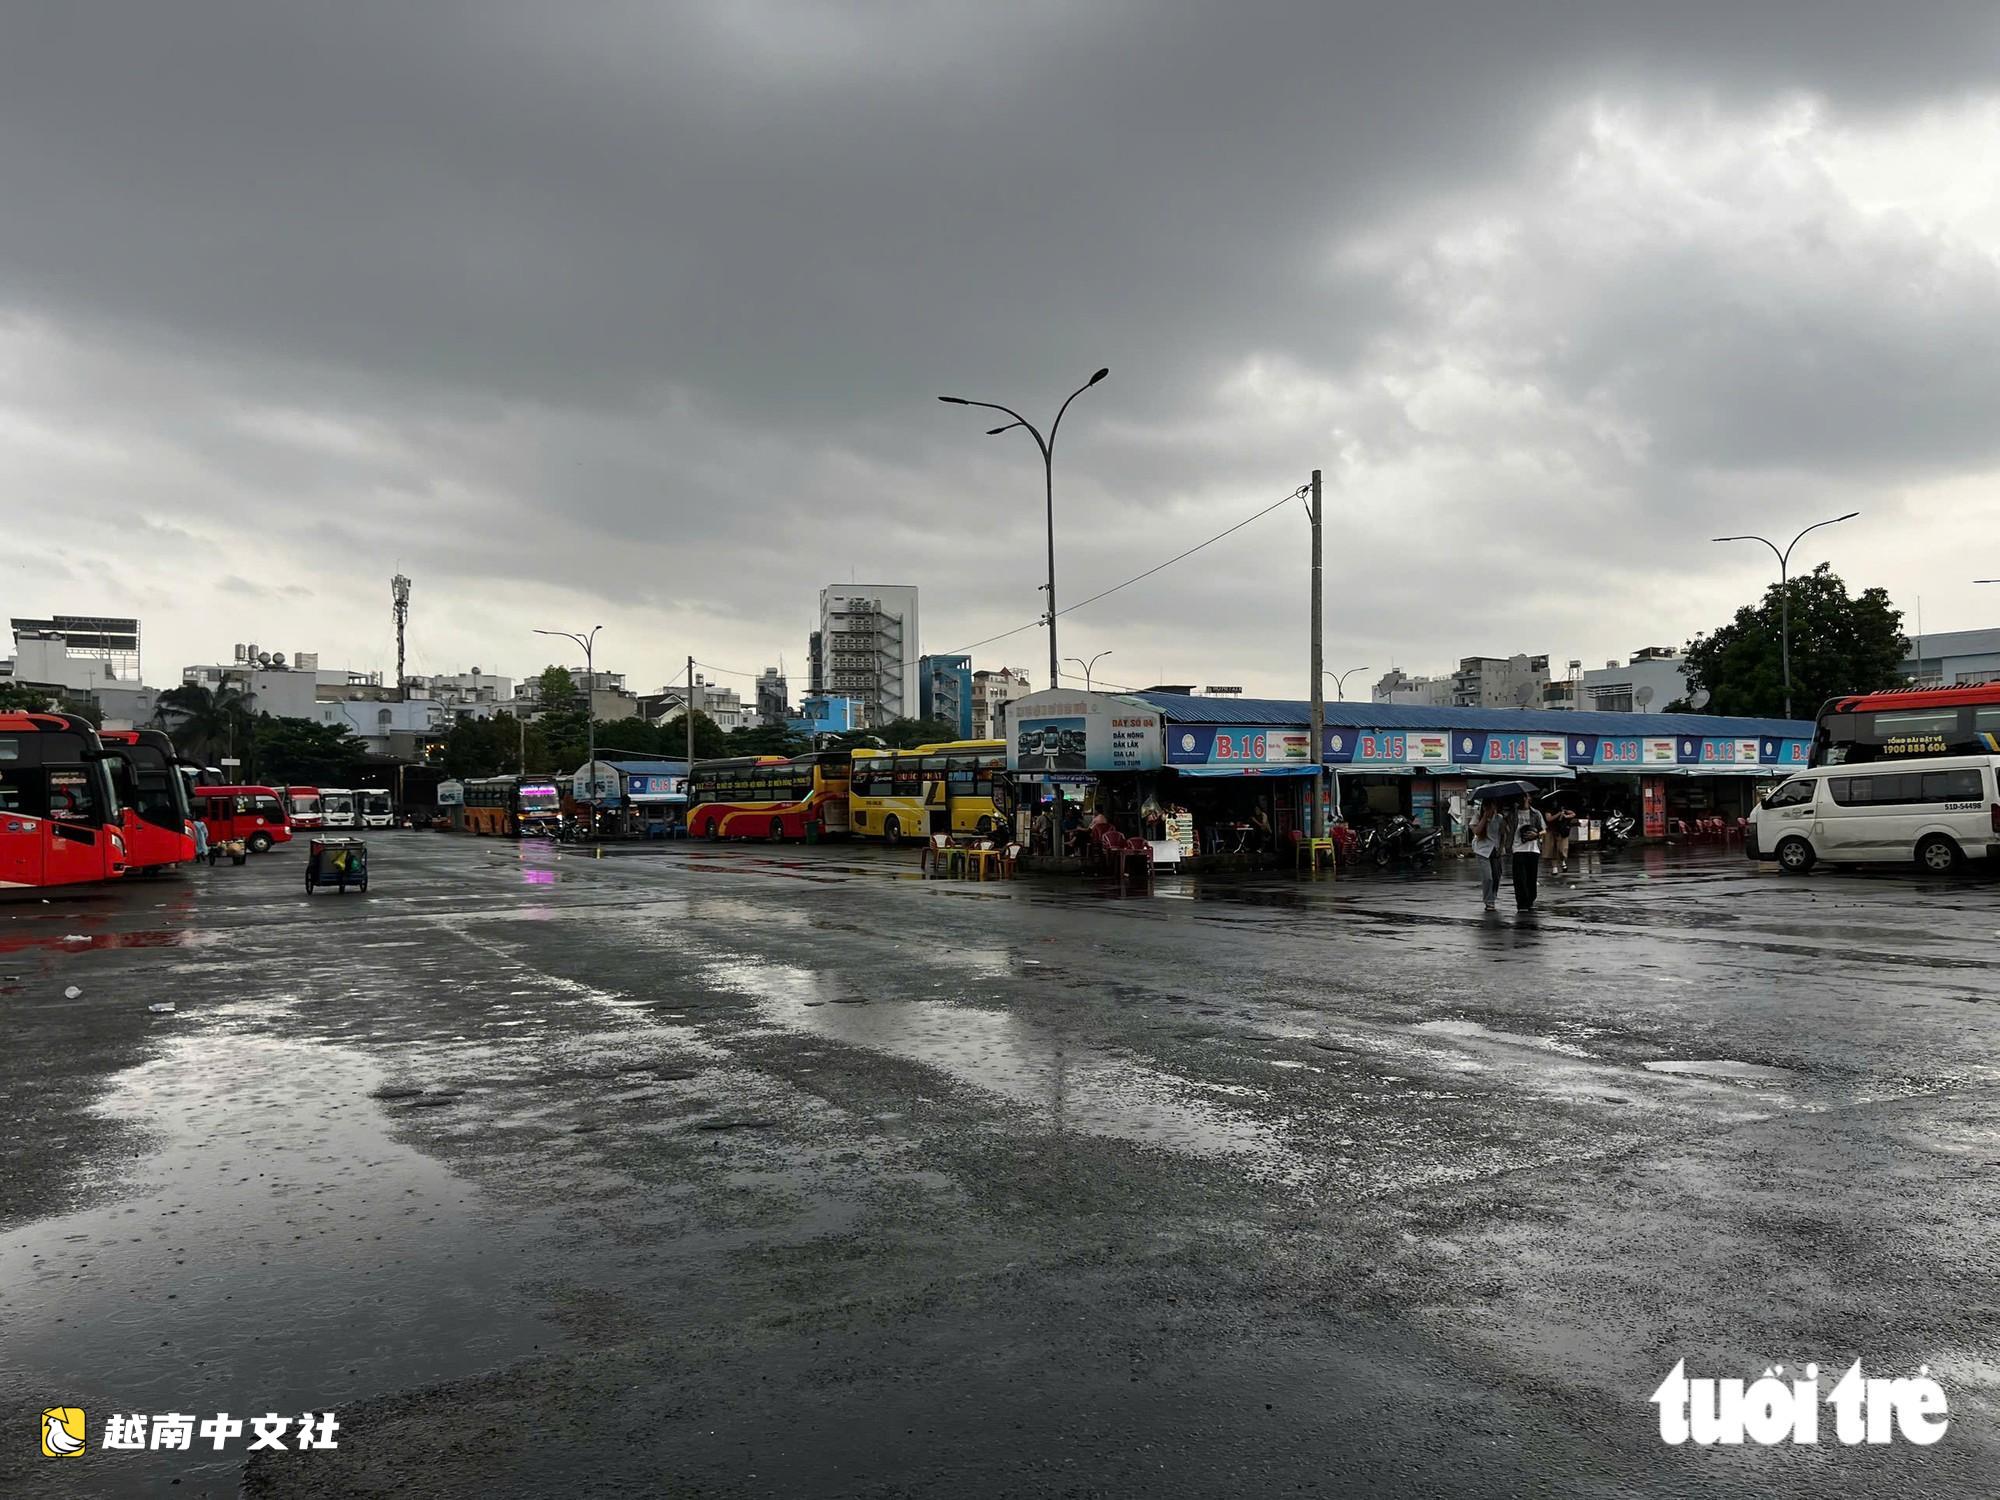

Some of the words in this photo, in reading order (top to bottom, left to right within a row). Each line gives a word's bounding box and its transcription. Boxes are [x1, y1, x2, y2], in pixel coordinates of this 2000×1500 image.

[1215, 734, 1265, 759] B.16
[1361, 736, 1404, 759] B.15
[1488, 739, 1527, 760] B.14
[1602, 741, 1638, 761] B.13
[1704, 742, 1735, 761] B.12
[1883, 745, 1906, 754] 1900
[1907, 744, 1926, 753] 888
[1927, 743, 1947, 752] 606
